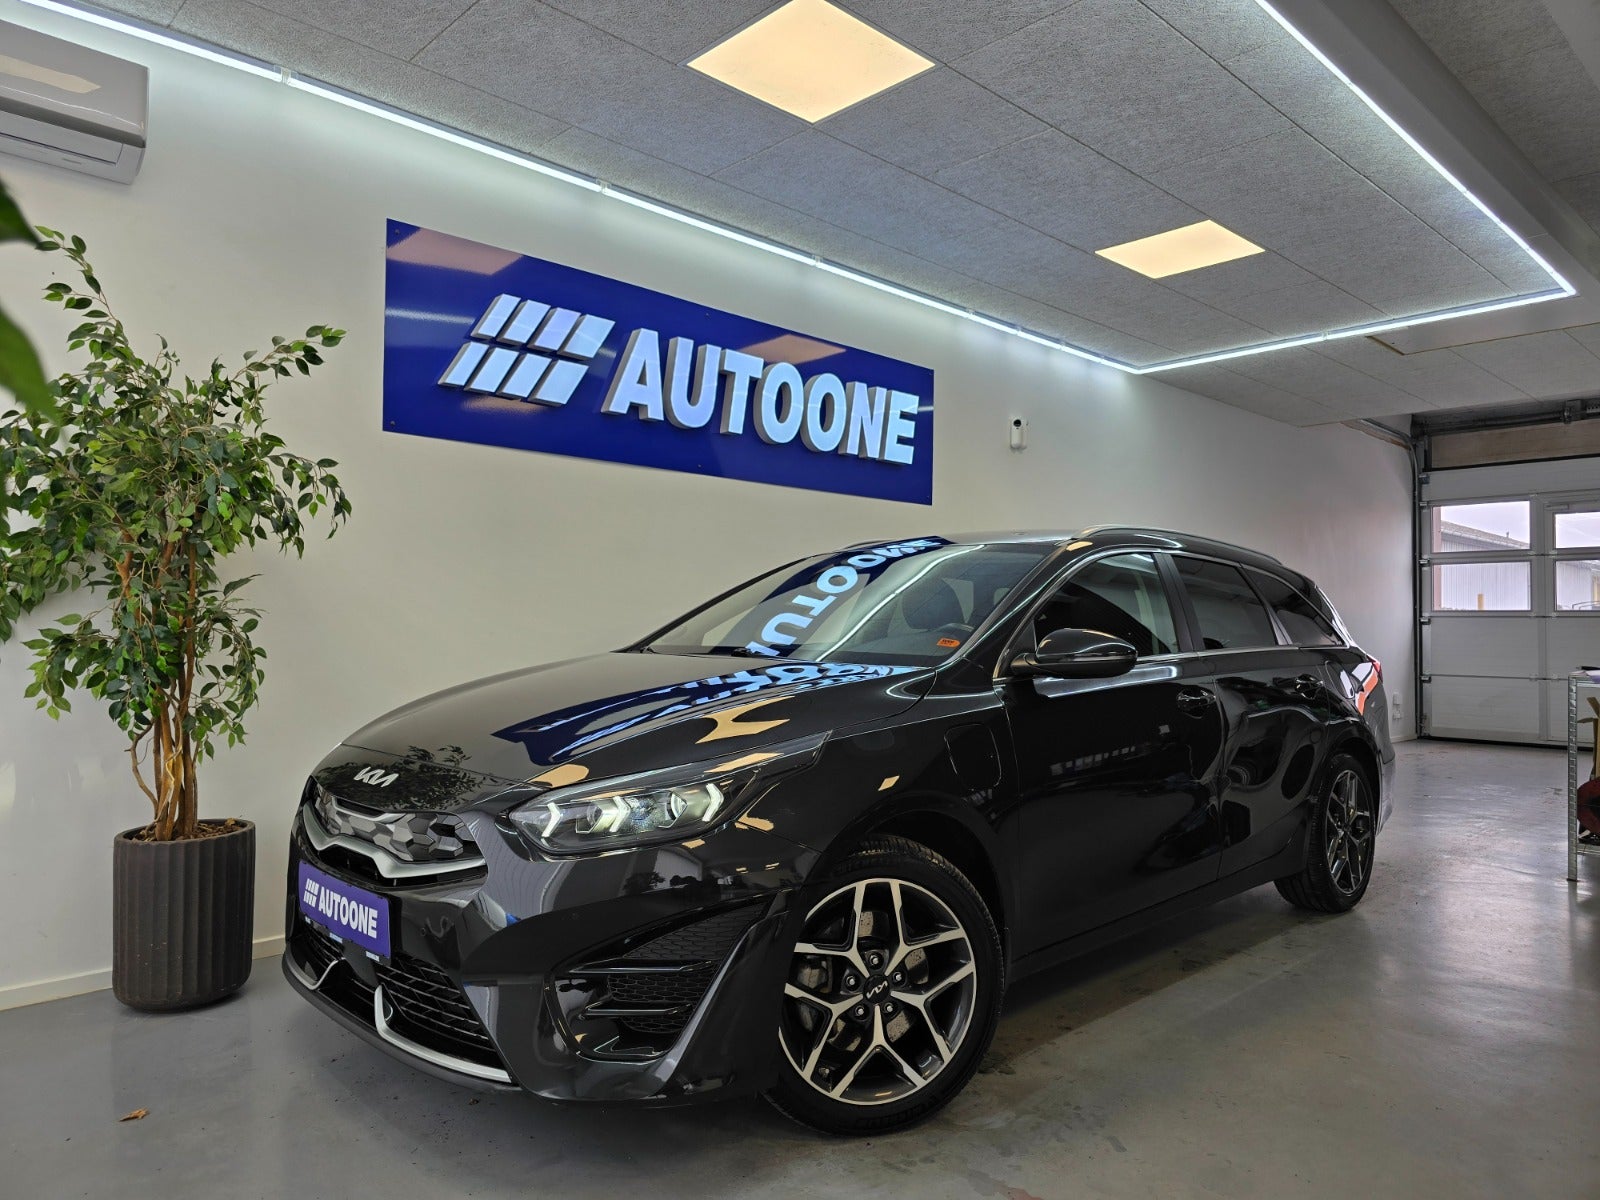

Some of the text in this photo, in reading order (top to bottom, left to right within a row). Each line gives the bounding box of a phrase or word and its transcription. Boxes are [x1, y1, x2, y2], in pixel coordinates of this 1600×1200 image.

[601, 328, 919, 464] AUTOONE
[353, 766, 399, 787] KIA
[318, 886, 378, 939] AUTOONE
